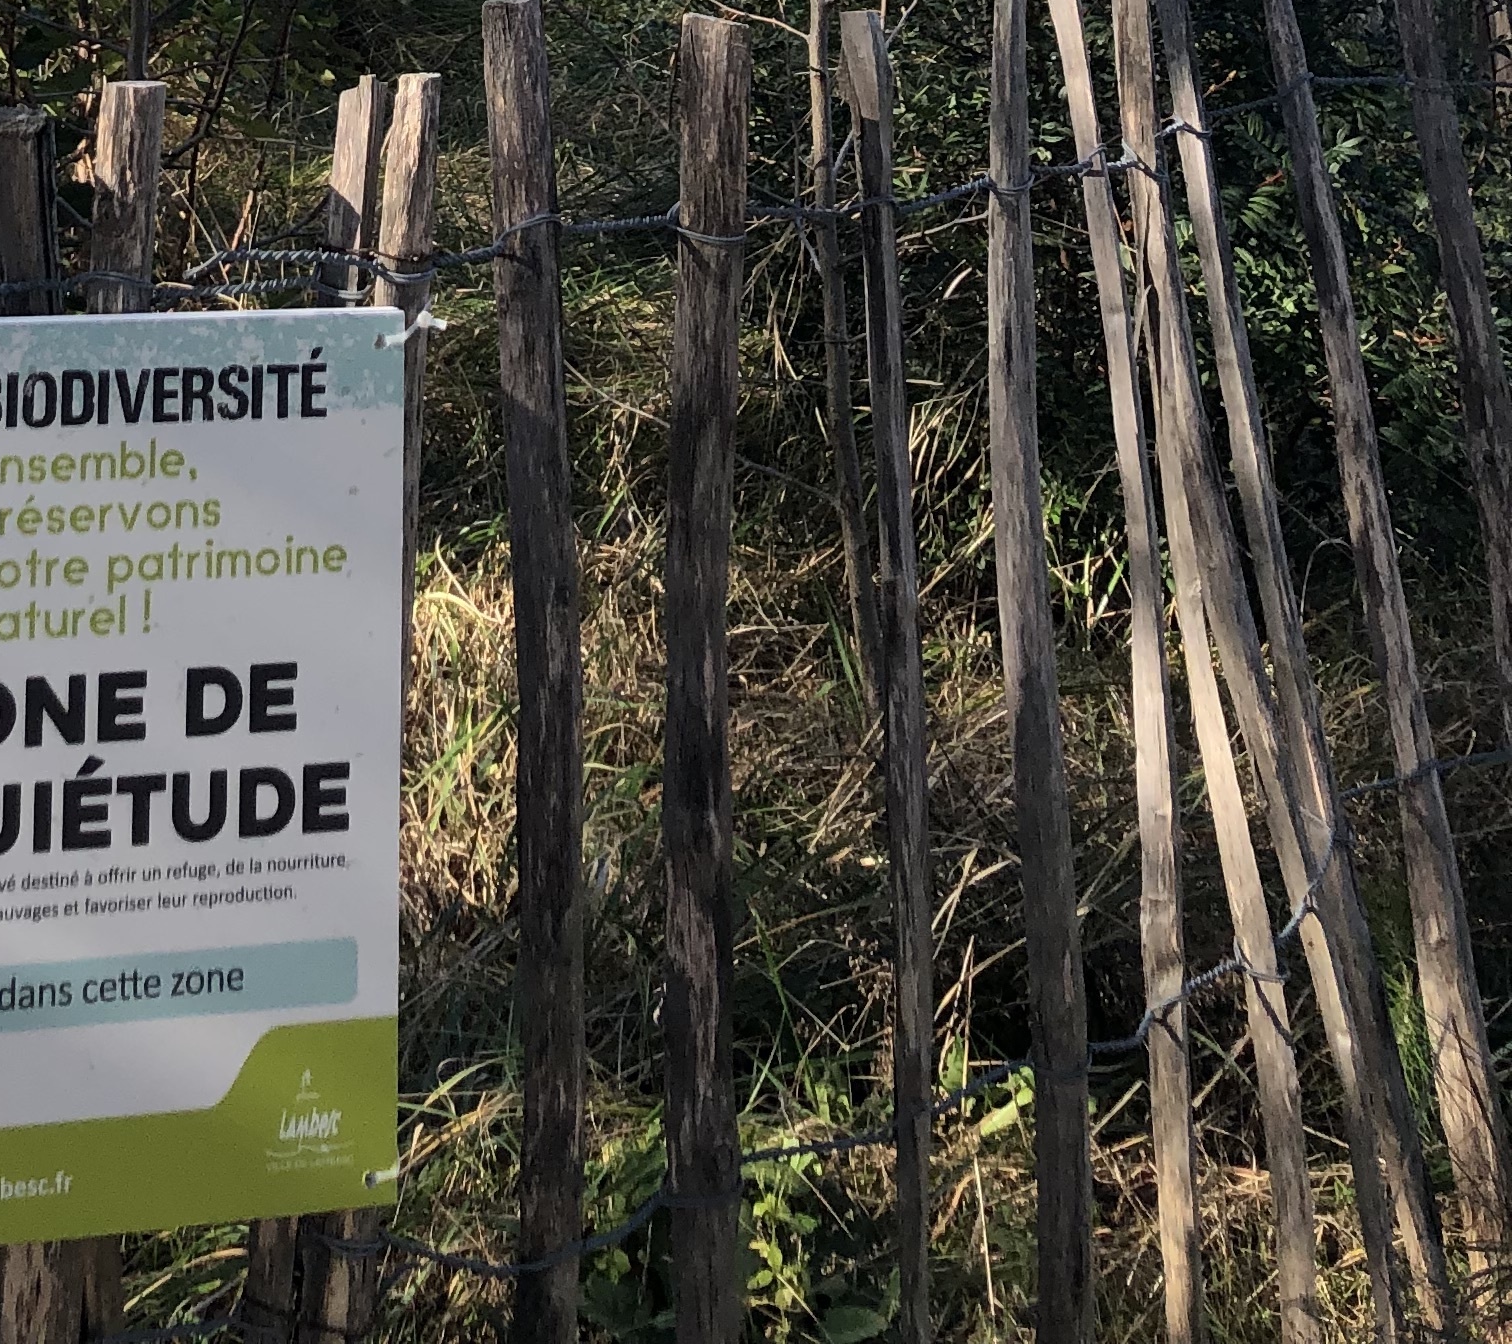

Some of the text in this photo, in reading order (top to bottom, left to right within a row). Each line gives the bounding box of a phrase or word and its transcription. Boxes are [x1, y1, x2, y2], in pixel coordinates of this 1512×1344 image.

[106, 534, 348, 596] patrimoine
[185, 661, 298, 738] DE
[20, 870, 79, 892] destiné
[84, 869, 93, 887] à
[97, 867, 137, 886] offrir
[141, 866, 162, 883] un
[165, 861, 221, 882] refuge,
[225, 858, 245, 876] de
[249, 857, 262, 874] la
[63, 900, 80, 916] et
[85, 893, 153, 915] favoriser
[157, 891, 187, 909] leur
[81, 968, 162, 1006] cette
[170, 965, 245, 997] zone
